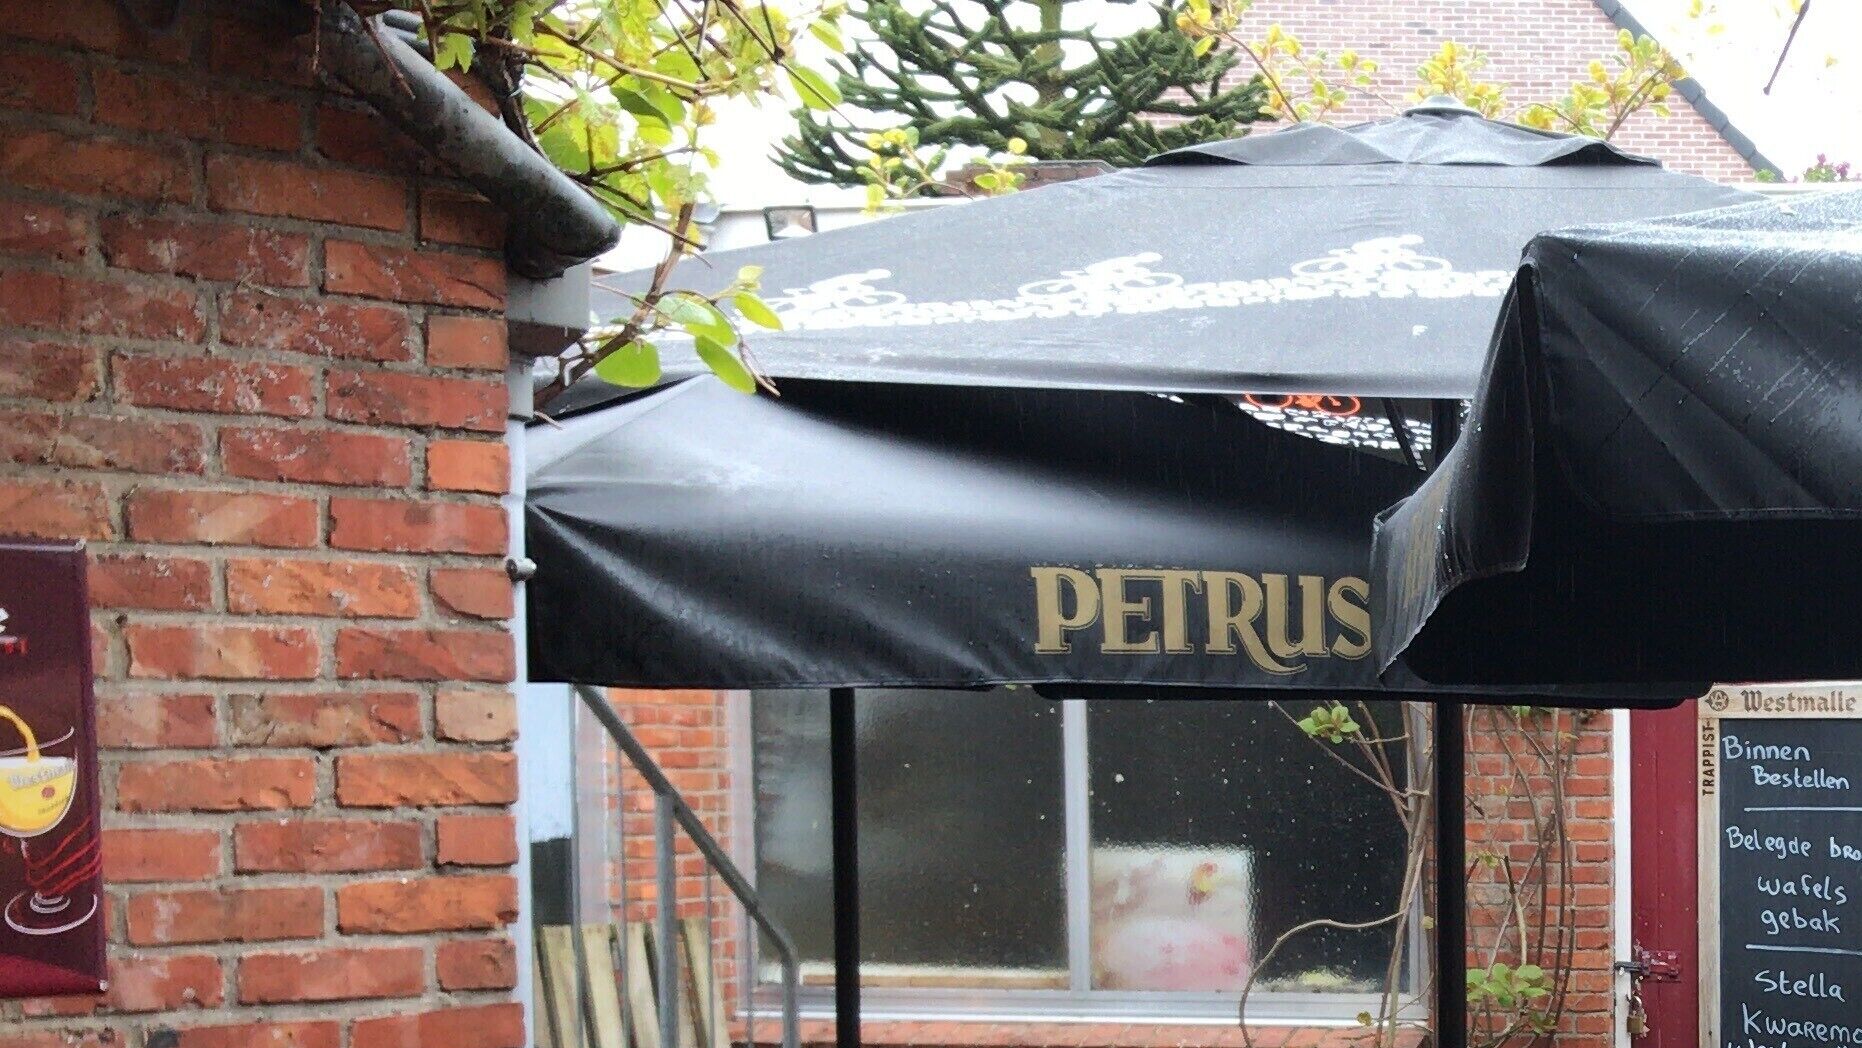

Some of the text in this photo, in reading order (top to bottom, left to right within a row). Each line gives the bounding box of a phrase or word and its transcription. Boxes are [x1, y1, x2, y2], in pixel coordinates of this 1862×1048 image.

[1030, 566, 1373, 676] PETRUS
[1741, 690, 1857, 713] Westmalle
[1702, 724, 1715, 796] TRAPPIST
[1722, 735, 1811, 761] Binnen
[1751, 765, 1850, 790] Bestellen
[1725, 825, 1812, 860] Belegde
[1757, 873, 1847, 906] wafels
[1760, 906, 1841, 935] gebak
[1754, 969, 1846, 1003] Stella
